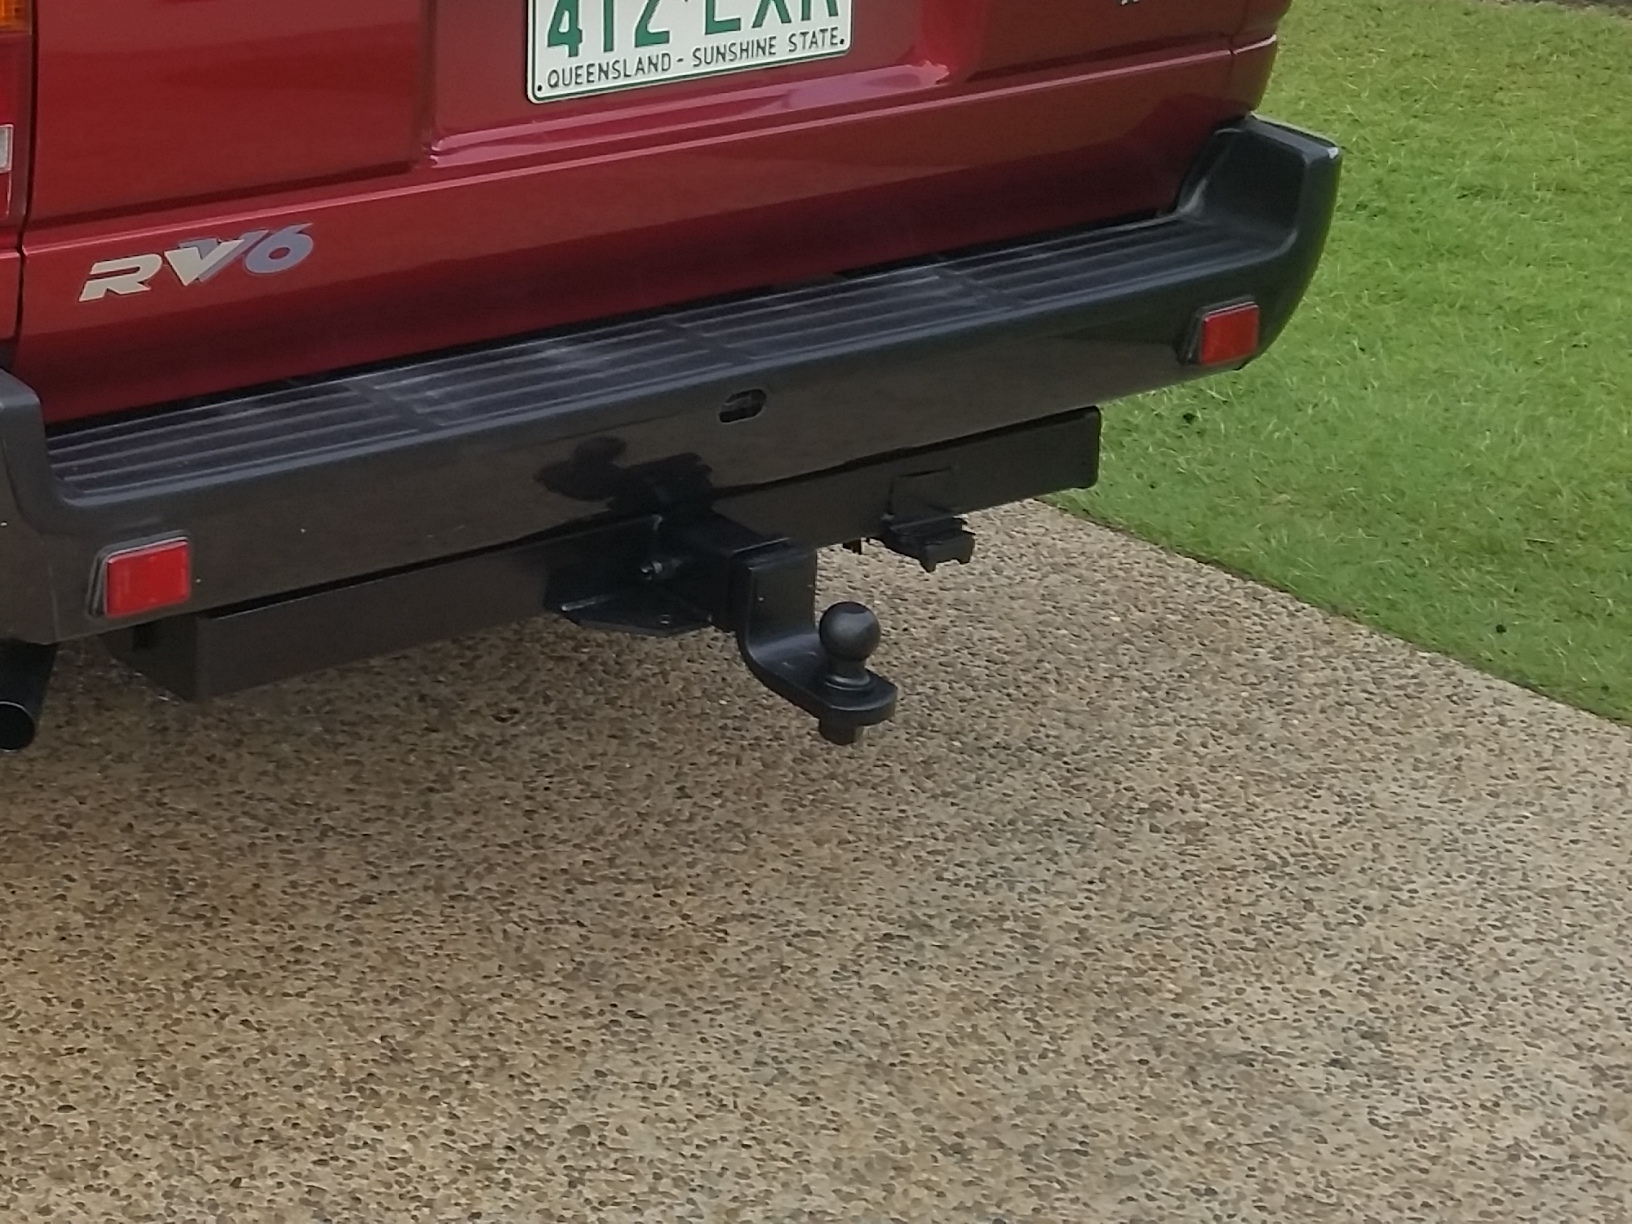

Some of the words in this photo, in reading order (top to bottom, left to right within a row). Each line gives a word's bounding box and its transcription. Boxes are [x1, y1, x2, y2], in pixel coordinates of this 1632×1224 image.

[546, 54, 672, 89] QUEENSLAND
[691, 37, 777, 68] SUNSHINE
[788, 26, 838, 53] STATE
